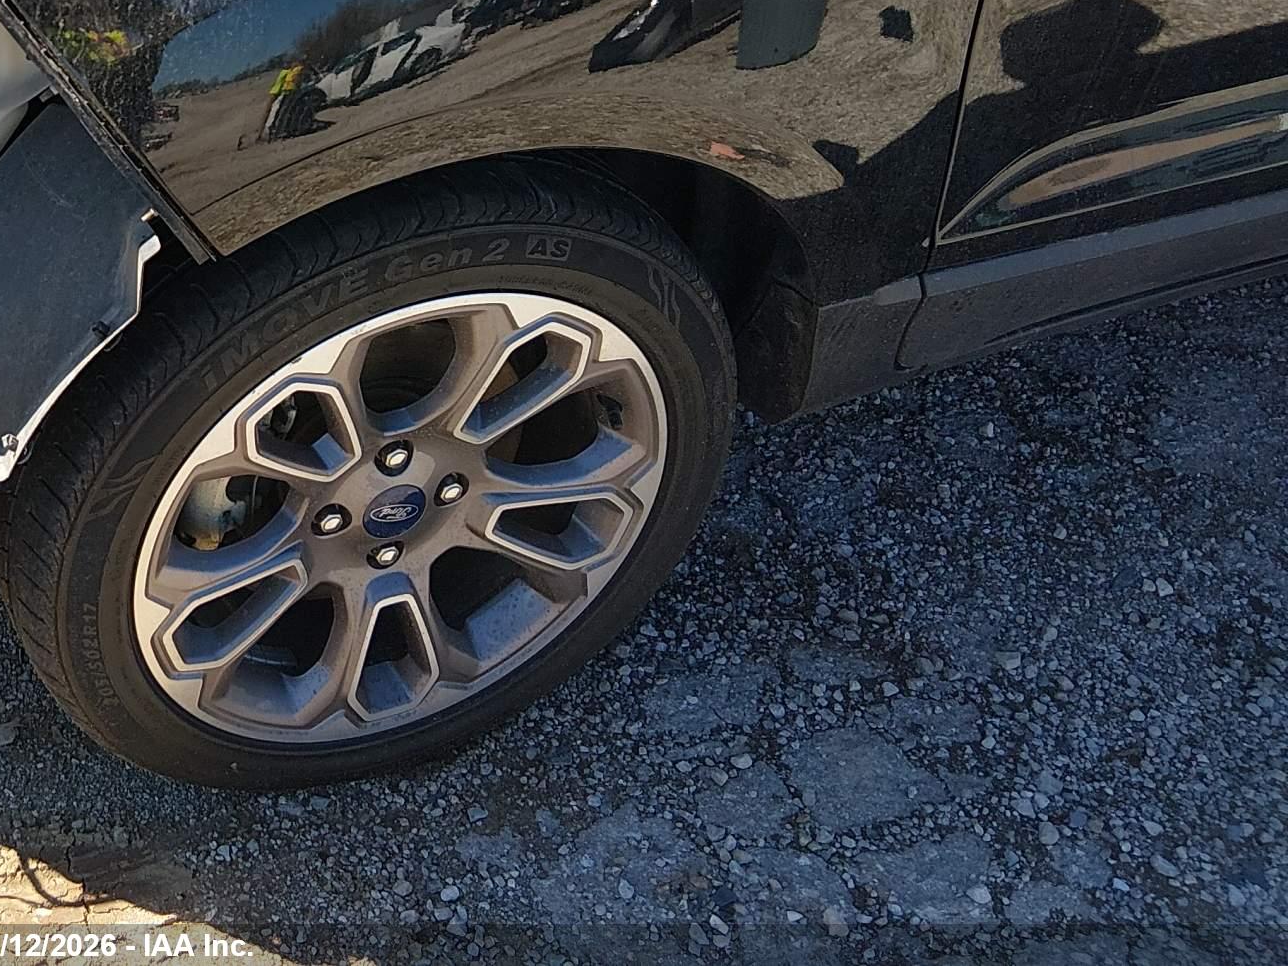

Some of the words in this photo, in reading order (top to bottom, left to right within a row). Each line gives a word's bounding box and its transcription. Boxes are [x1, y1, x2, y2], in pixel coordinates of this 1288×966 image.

[384, 246, 473, 283] Gen
[482, 237, 511, 263] 2
[526, 237, 571, 259] AS
[376, 506, 414, 520] Ford
